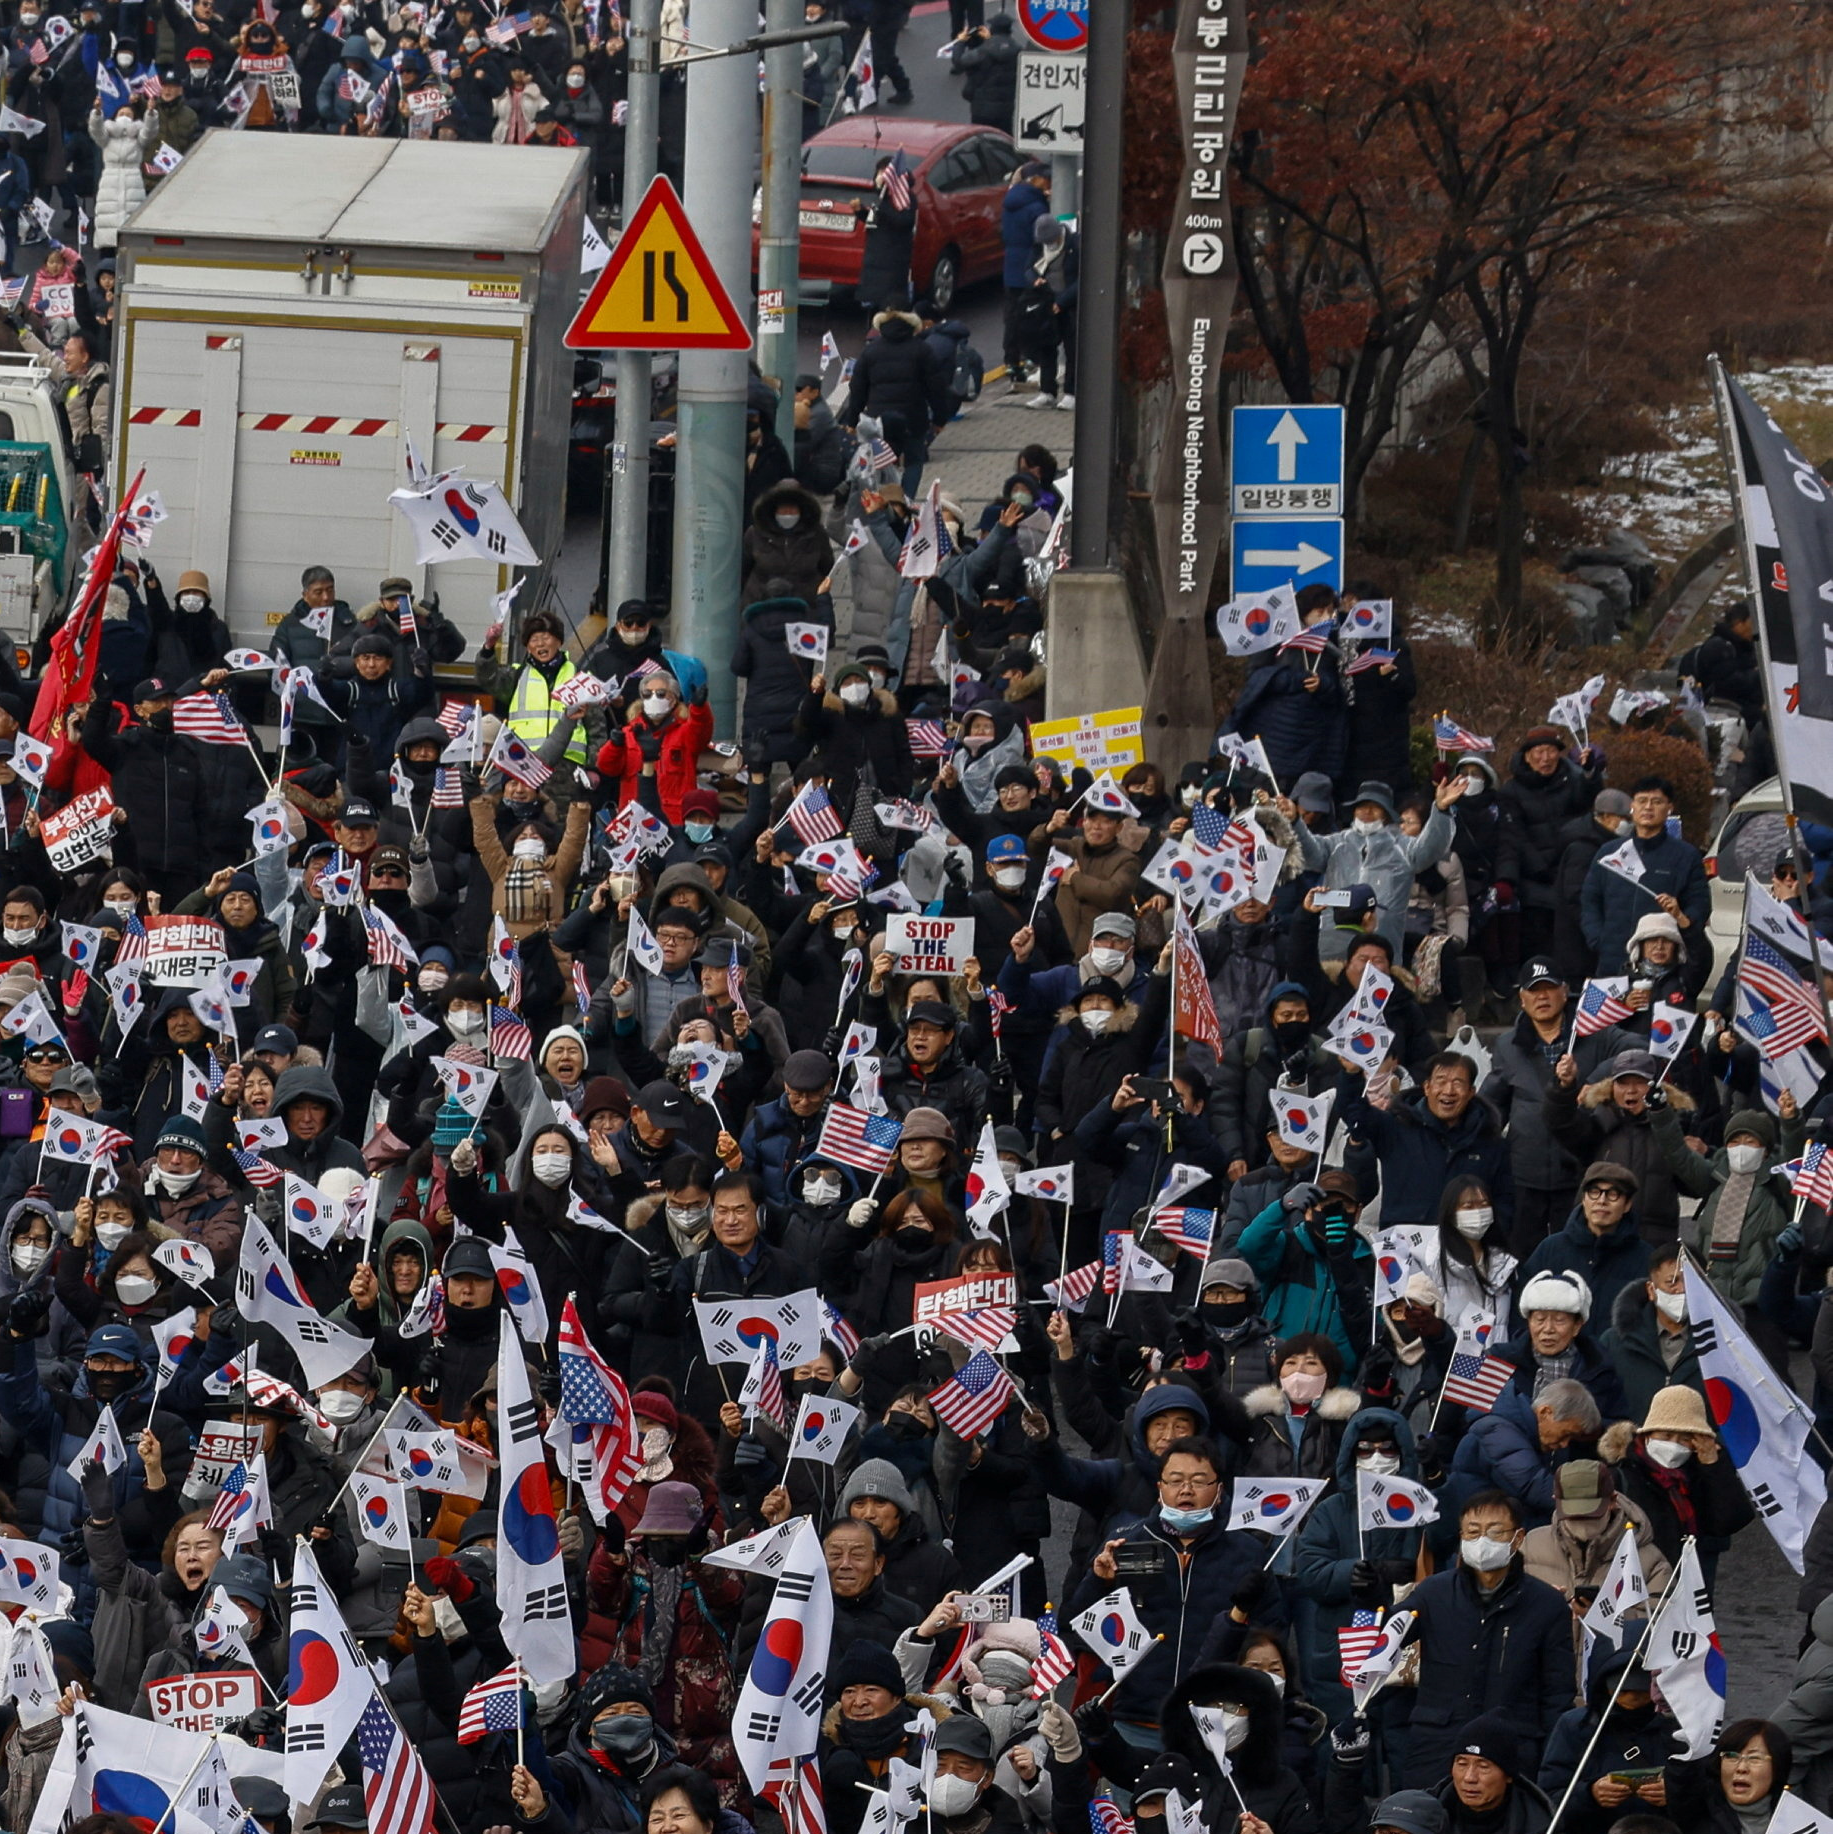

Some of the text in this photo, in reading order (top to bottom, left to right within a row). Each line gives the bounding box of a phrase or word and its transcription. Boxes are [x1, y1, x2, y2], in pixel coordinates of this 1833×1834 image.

[1185, 215, 1222, 229] 400m
[1178, 318, 1210, 595] Eungbong Neighborhood Park
[1241, 488, 1333, 510] 일방통행
[45, 787, 113, 837] 부정선거
[69, 820, 100, 843] OUT
[52, 828, 119, 871] 입법독
[148, 925, 226, 953] 탄핵반대
[906, 920, 957, 940] STOP
[912, 939, 948, 956] THE
[146, 956, 219, 980] 이재명구
[900, 956, 957, 973] STEAL
[917, 1275, 1017, 1323] 탄핵반대
[155, 1679, 240, 1717] STOP
